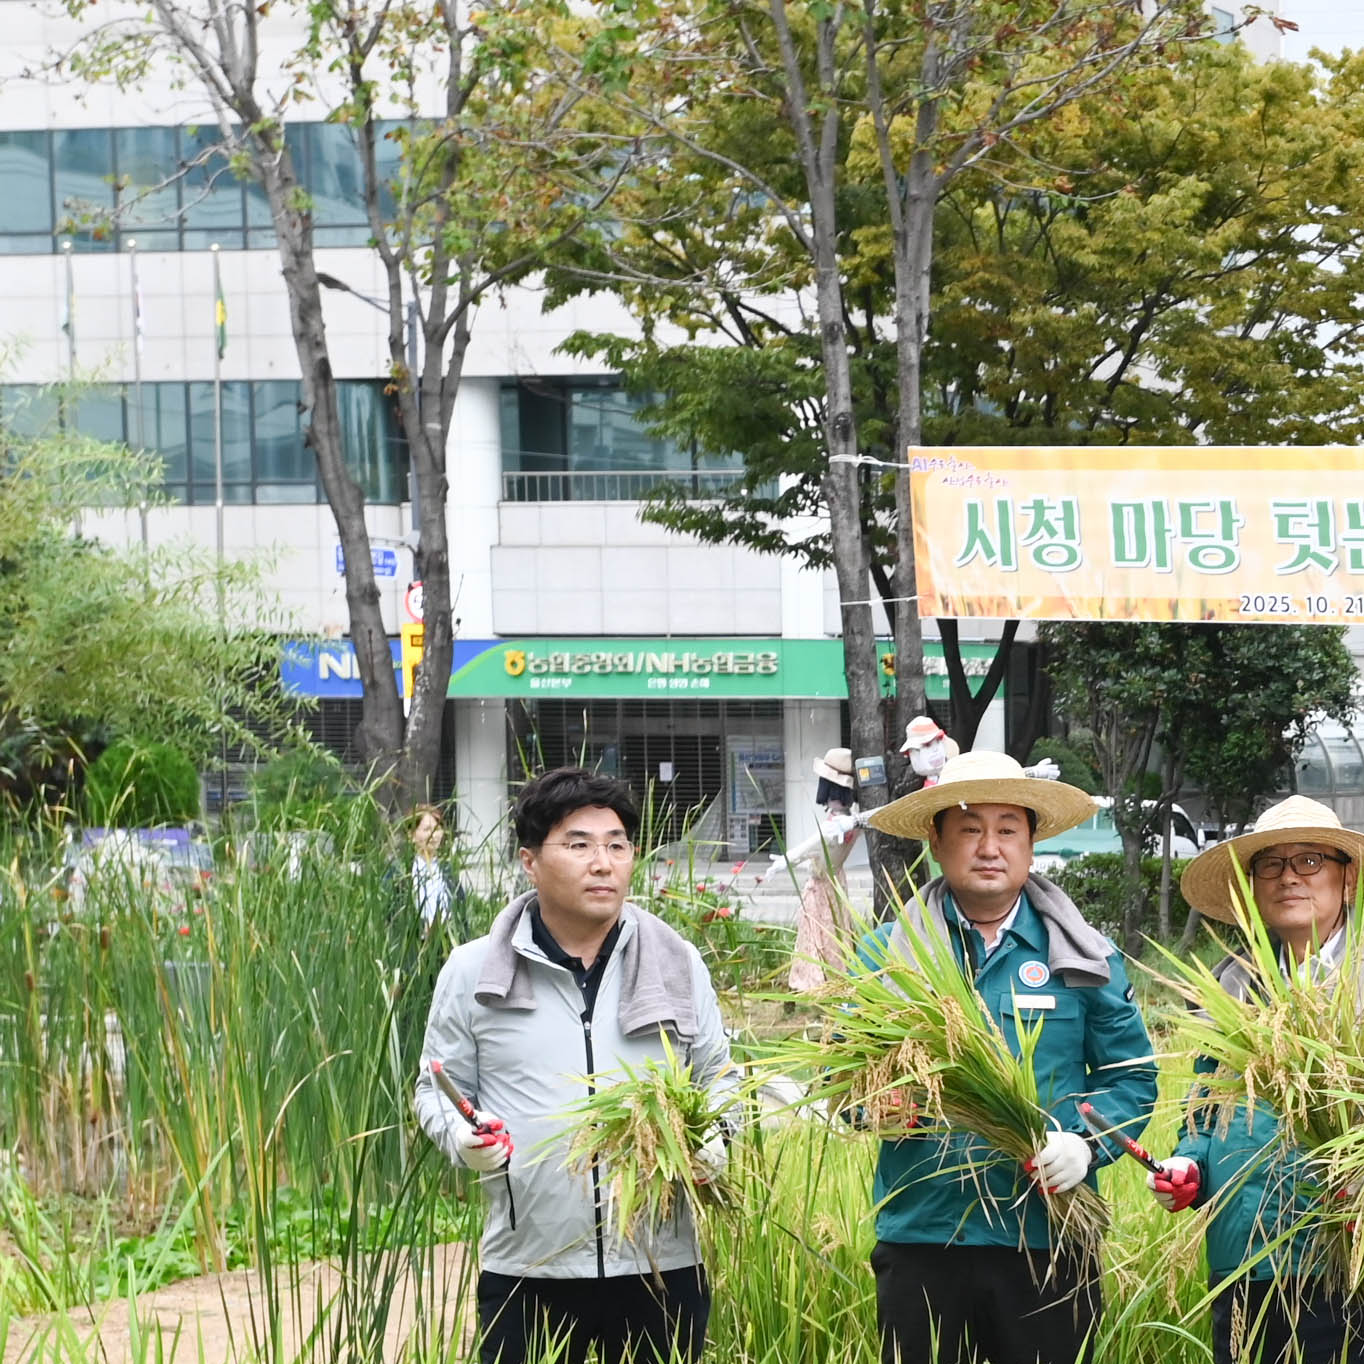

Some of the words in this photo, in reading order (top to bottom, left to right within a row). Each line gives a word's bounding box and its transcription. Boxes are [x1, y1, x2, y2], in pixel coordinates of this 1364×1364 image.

[955, 498, 1080, 569] 시청
[1112, 499, 1243, 570] 마당
[1240, 595, 1297, 615] 2025.
[1305, 596, 1335, 616] 10.
